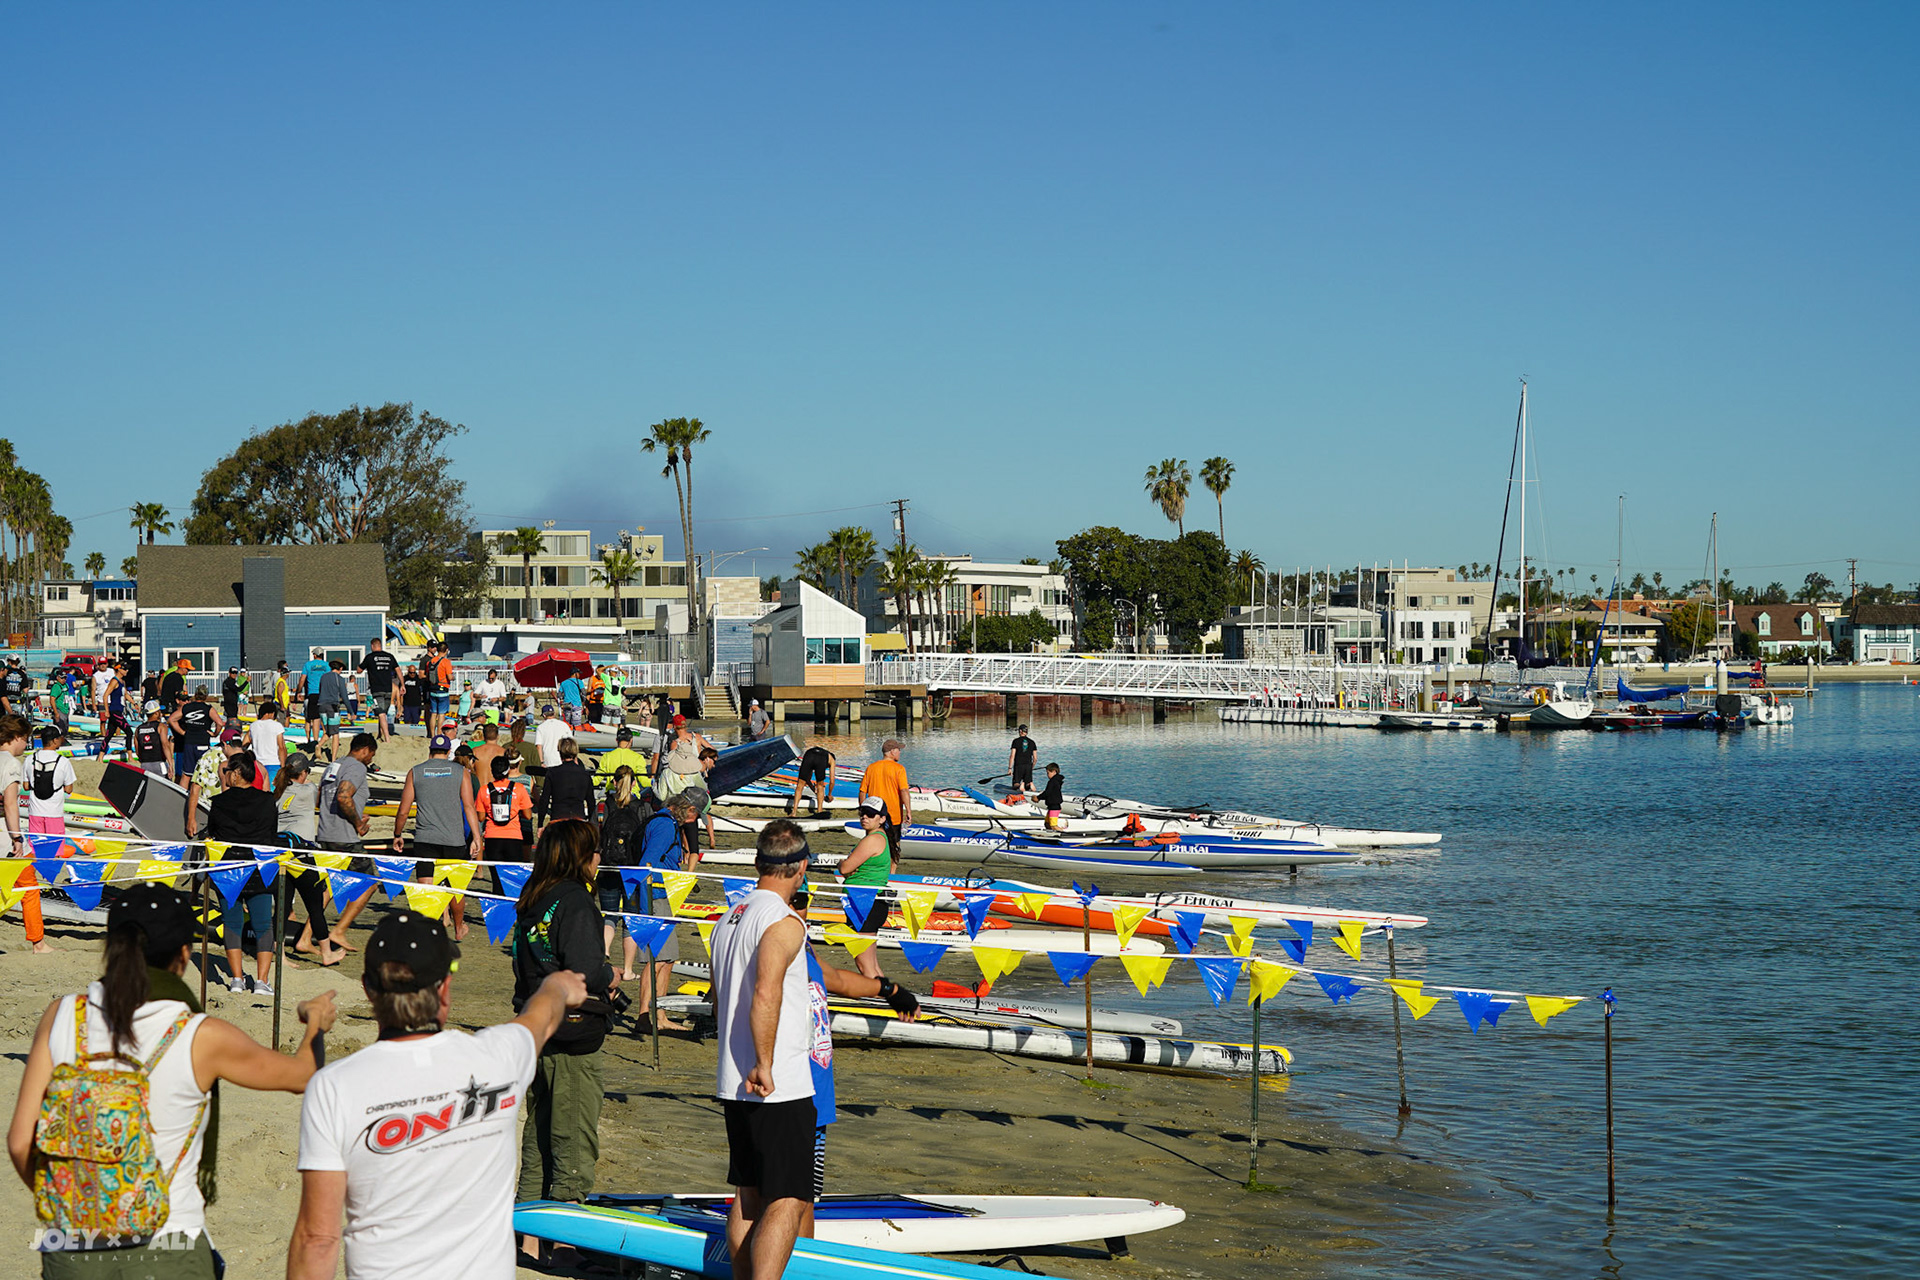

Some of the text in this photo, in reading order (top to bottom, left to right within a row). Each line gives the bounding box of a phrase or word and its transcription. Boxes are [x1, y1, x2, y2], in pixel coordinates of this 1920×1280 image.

[946, 803, 980, 812] Kaimana
[1184, 895, 1233, 908] EHUKAI
[1022, 1004, 1058, 1014] MELVIN
[1220, 1049, 1261, 1061] INFINI
[365, 1092, 450, 1115] CHAMPIONS TRUST
[375, 1100, 456, 1149] ON
